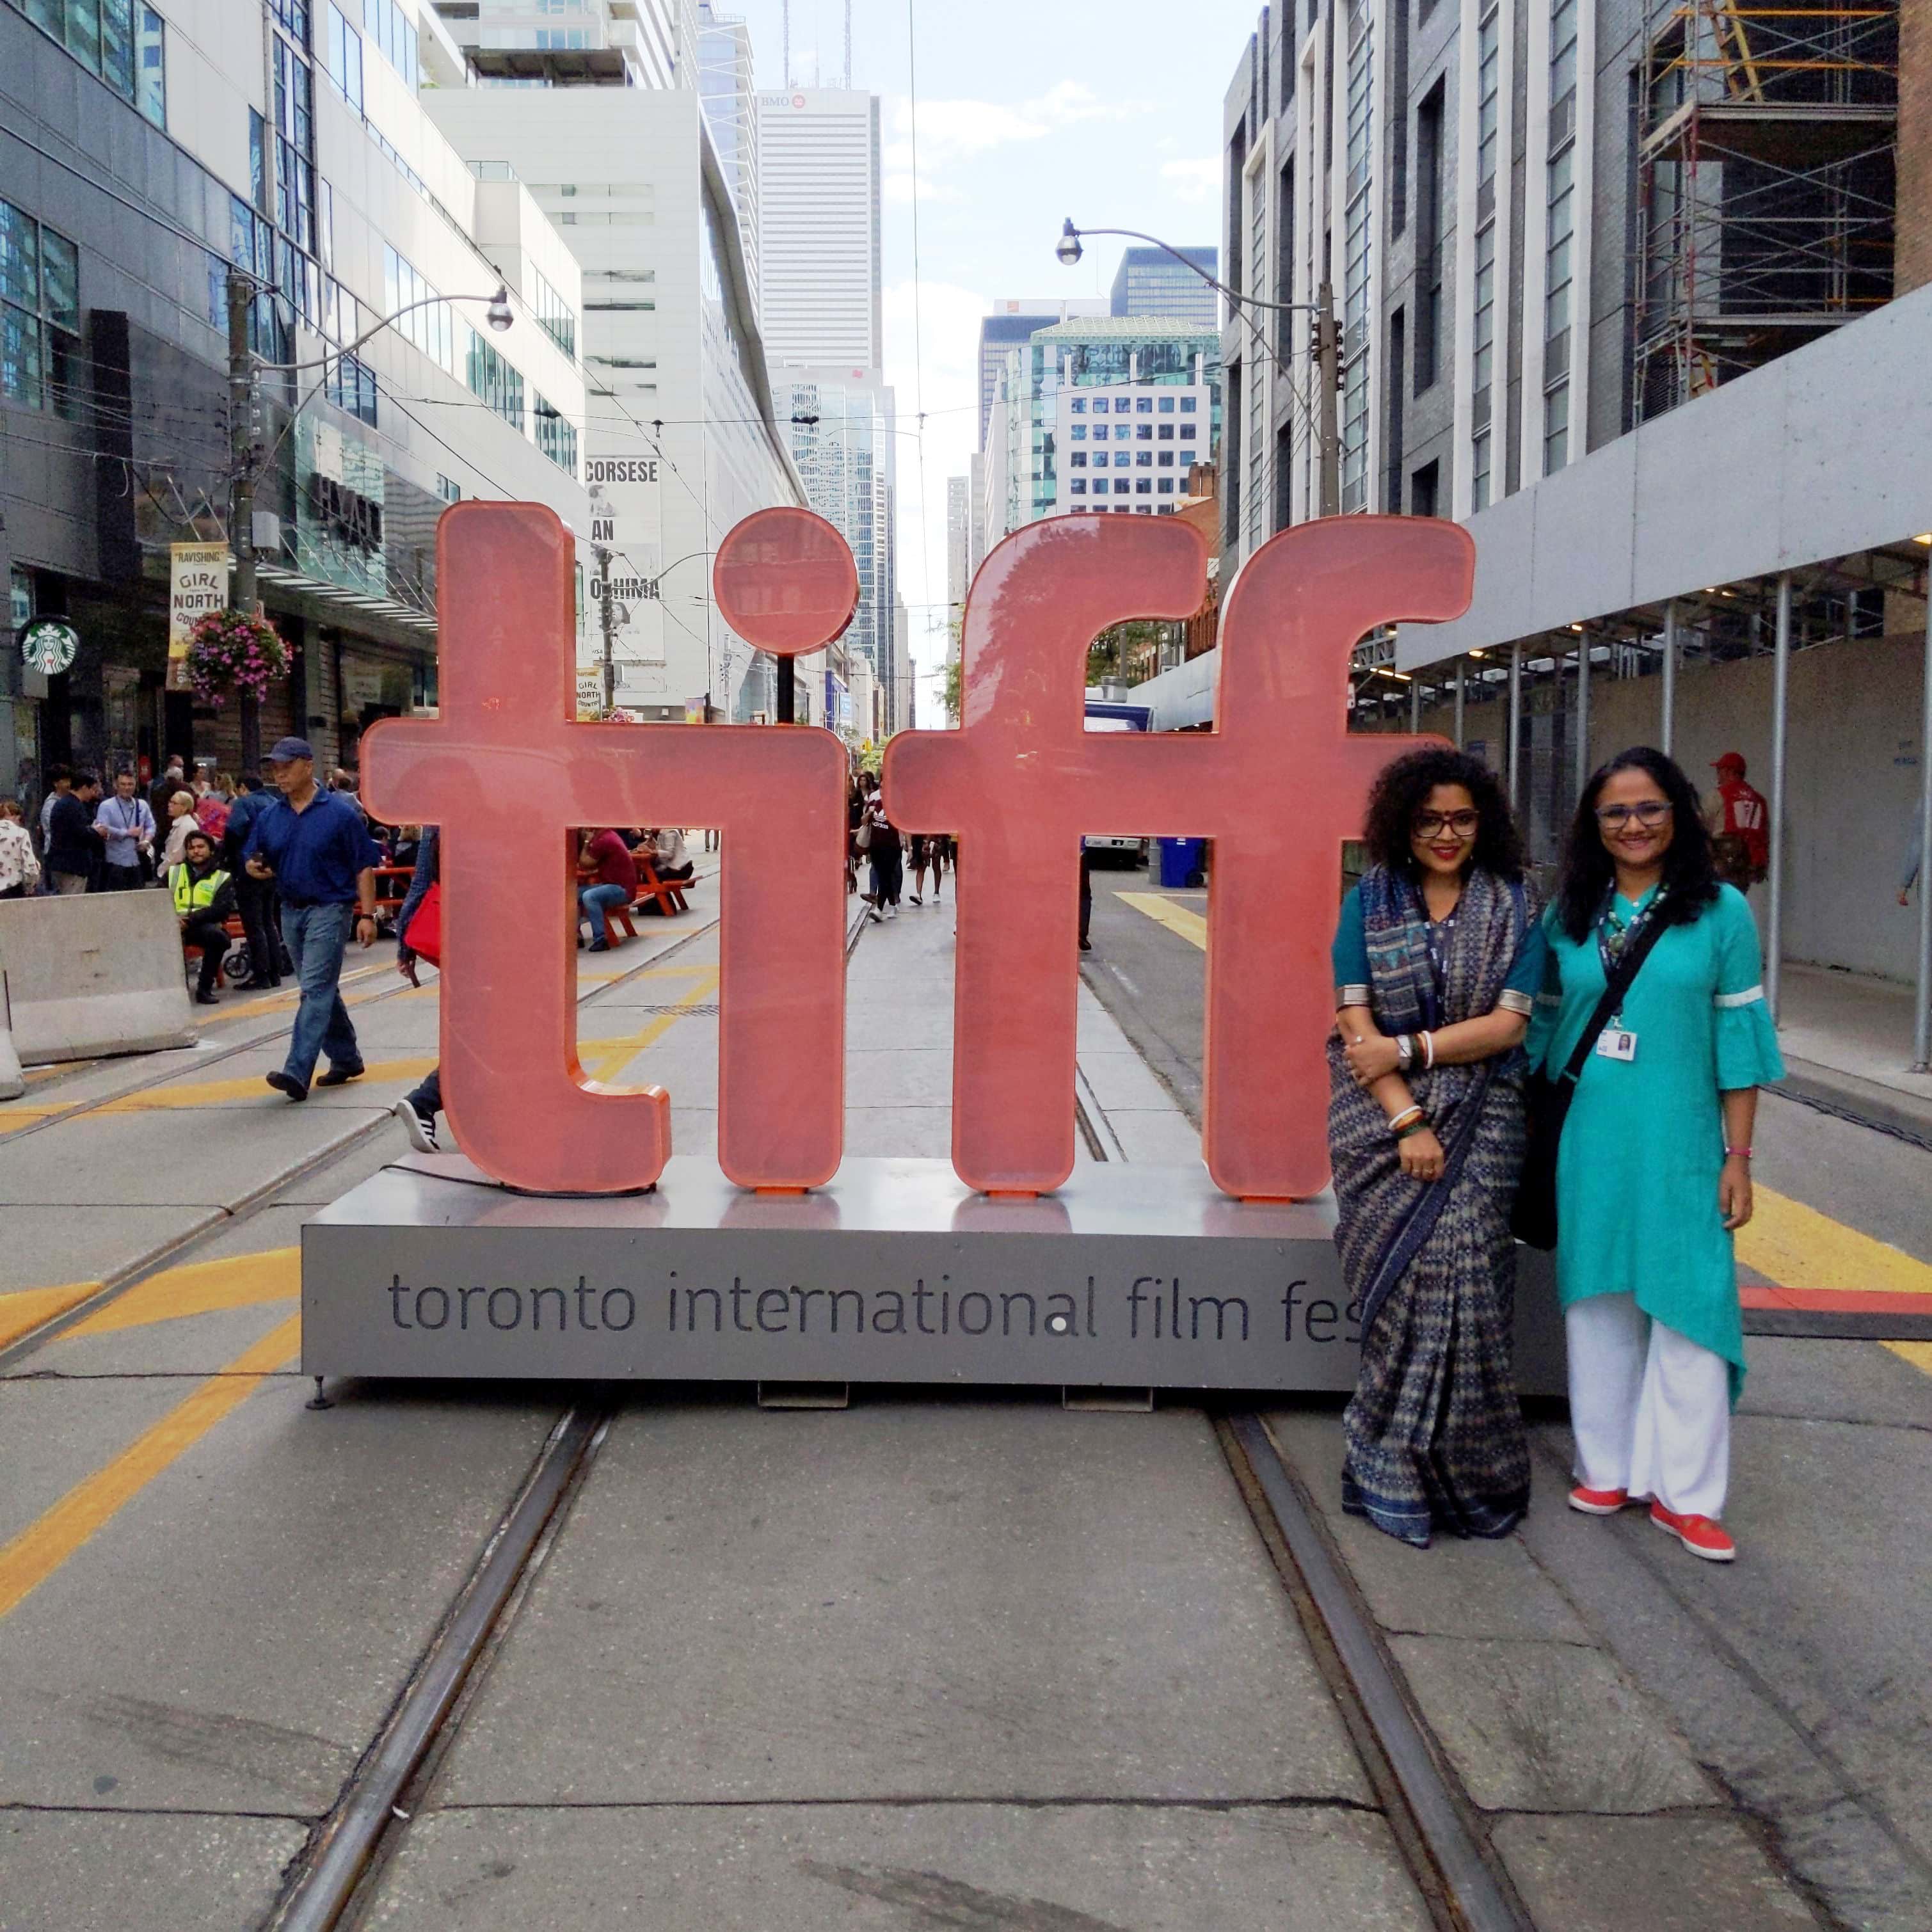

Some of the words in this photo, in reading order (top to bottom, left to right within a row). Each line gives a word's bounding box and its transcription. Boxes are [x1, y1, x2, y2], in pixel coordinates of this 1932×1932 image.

[762, 97, 789, 106] BMO
[591, 520, 614, 541] AN
[179, 573, 219, 589] GIRL
[590, 578, 660, 599] OHIMA
[173, 593, 224, 609] NORTH
[360, 501, 1476, 1201] tiff
[388, 1274, 635, 1331] toronto
[669, 1270, 1098, 1337] international
[1127, 1277, 1250, 1341] film
